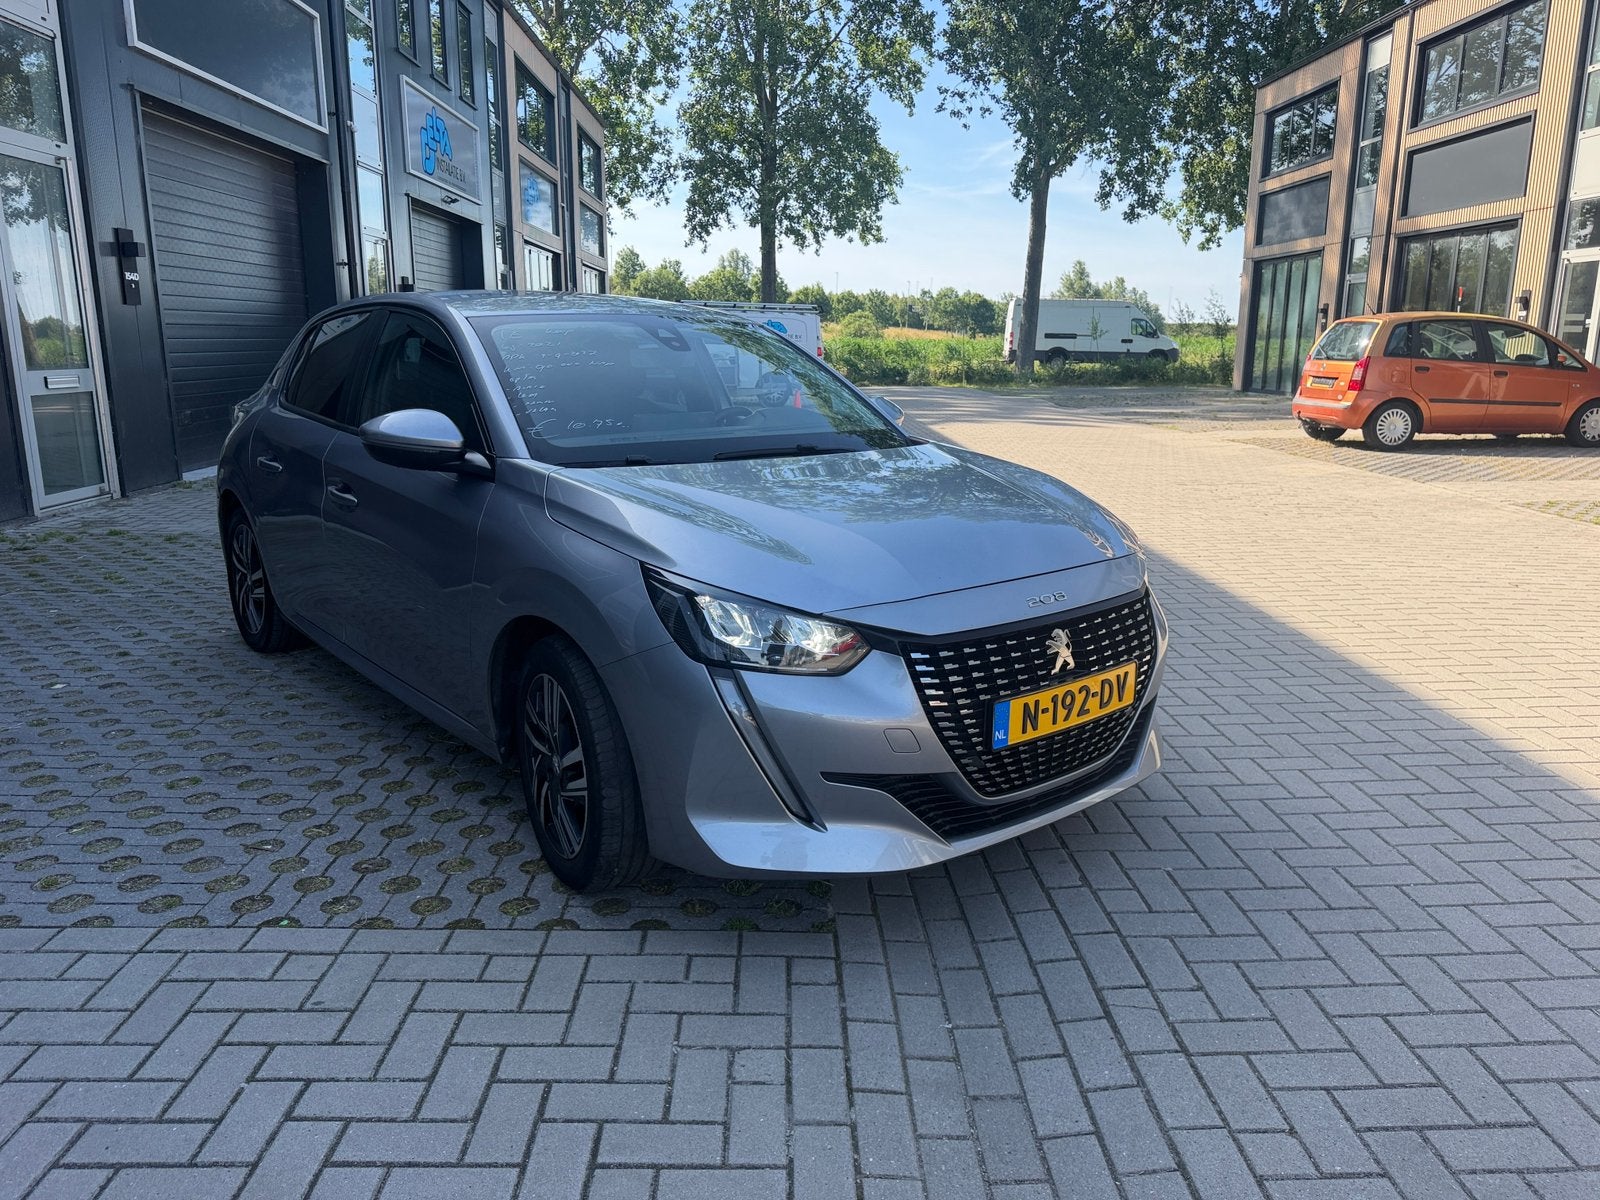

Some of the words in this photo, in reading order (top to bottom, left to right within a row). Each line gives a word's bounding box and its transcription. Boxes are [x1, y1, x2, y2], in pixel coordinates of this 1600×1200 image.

[124, 271, 140, 281] 154D
[1026, 590, 1068, 608] 208
[1021, 671, 1129, 735] N-192-DV
[994, 730, 1007, 741] NL
